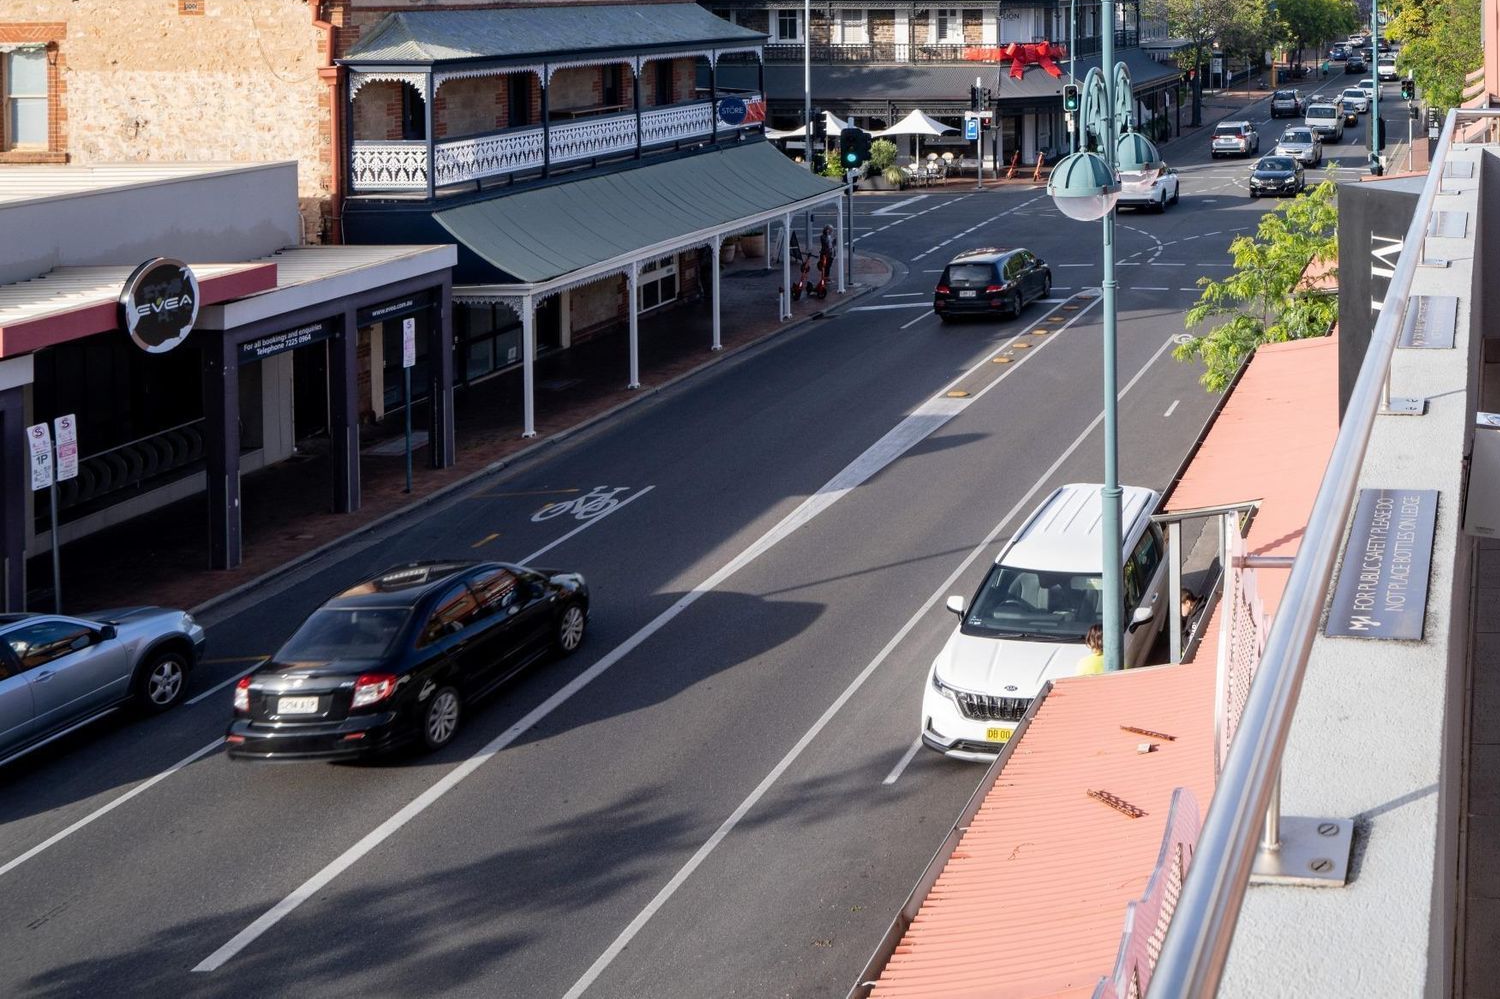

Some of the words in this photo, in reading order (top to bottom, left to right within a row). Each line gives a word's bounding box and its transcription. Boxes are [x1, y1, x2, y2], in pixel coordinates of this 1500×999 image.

[137, 294, 192, 316] EVEA
[243, 344, 254, 352] For
[262, 334, 287, 346] bookings
[287, 329, 298, 339] and
[298, 323, 322, 336] enquiries
[256, 342, 285, 355] Telephone
[285, 337, 298, 347] 7225
[36, 454, 48, 465] 1P
[1376, 498, 1395, 510] DO
[1401, 495, 1421, 517] LEDGE
[1371, 509, 1393, 534] PLEASE
[1399, 517, 1417, 531] ON
[1365, 533, 1387, 561] SAFETY
[1393, 531, 1415, 563] BOTTLES
[1359, 562, 1382, 591] PUBLIC
[1388, 564, 1411, 590] PLACE
[1354, 592, 1376, 611] FOR
[1385, 590, 1406, 612] NOT
